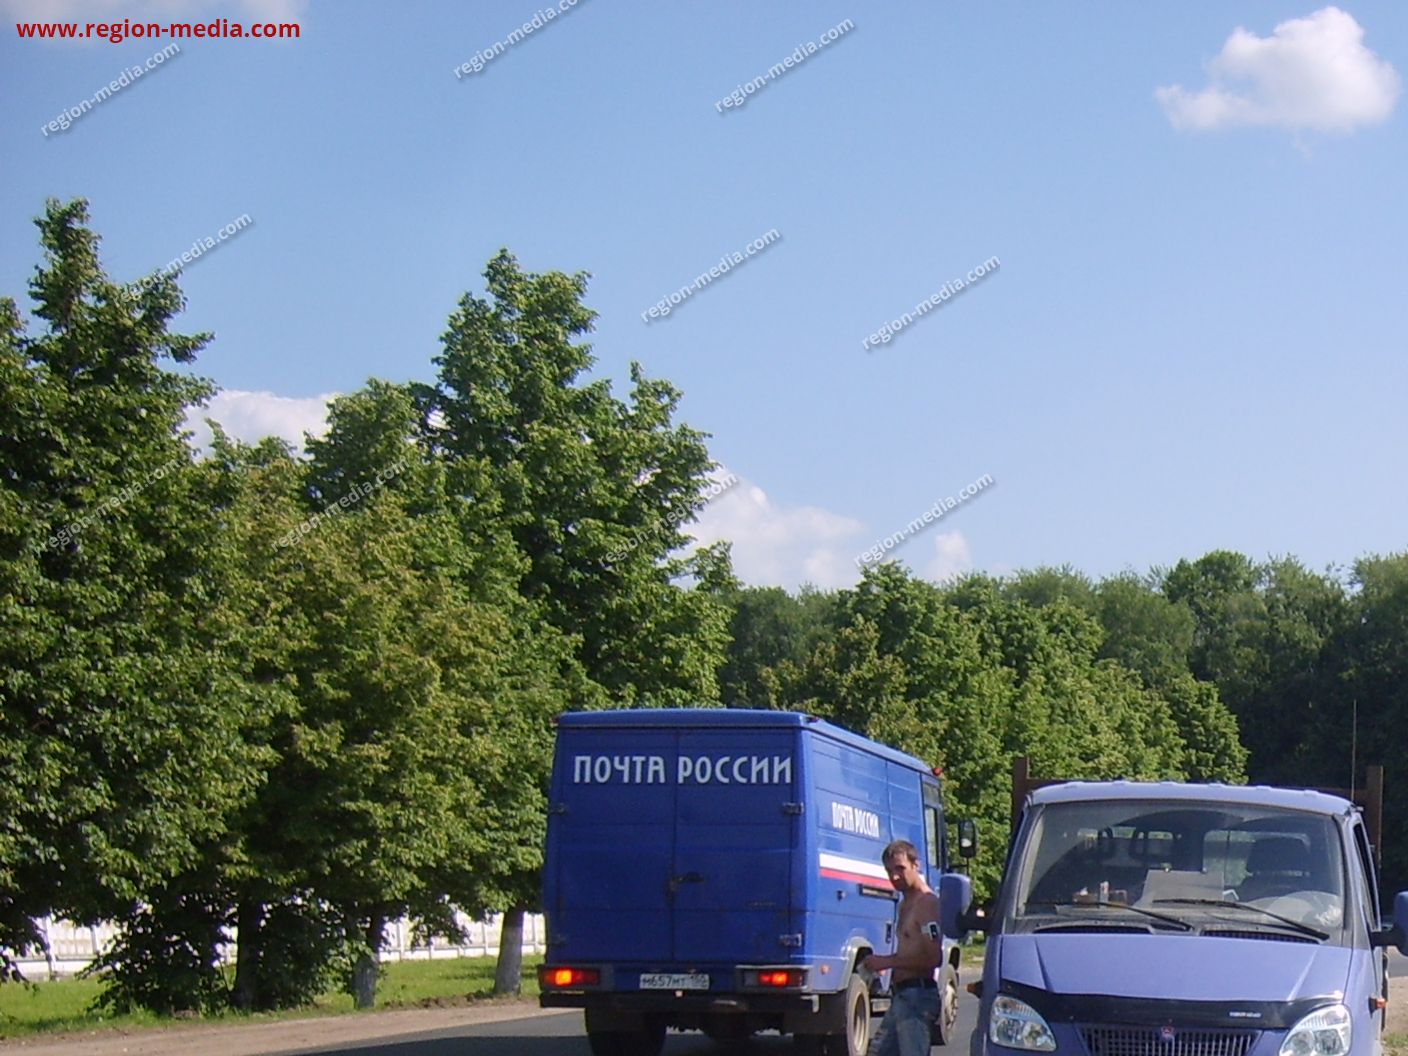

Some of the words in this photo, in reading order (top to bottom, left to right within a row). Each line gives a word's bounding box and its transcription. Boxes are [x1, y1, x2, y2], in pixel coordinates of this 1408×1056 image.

[573, 755, 666, 784] ПОЧТА
[677, 755, 793, 785] РОССИИ
[832, 801, 855, 832] ПОЧТА
[855, 807, 880, 838] РОССИИ
